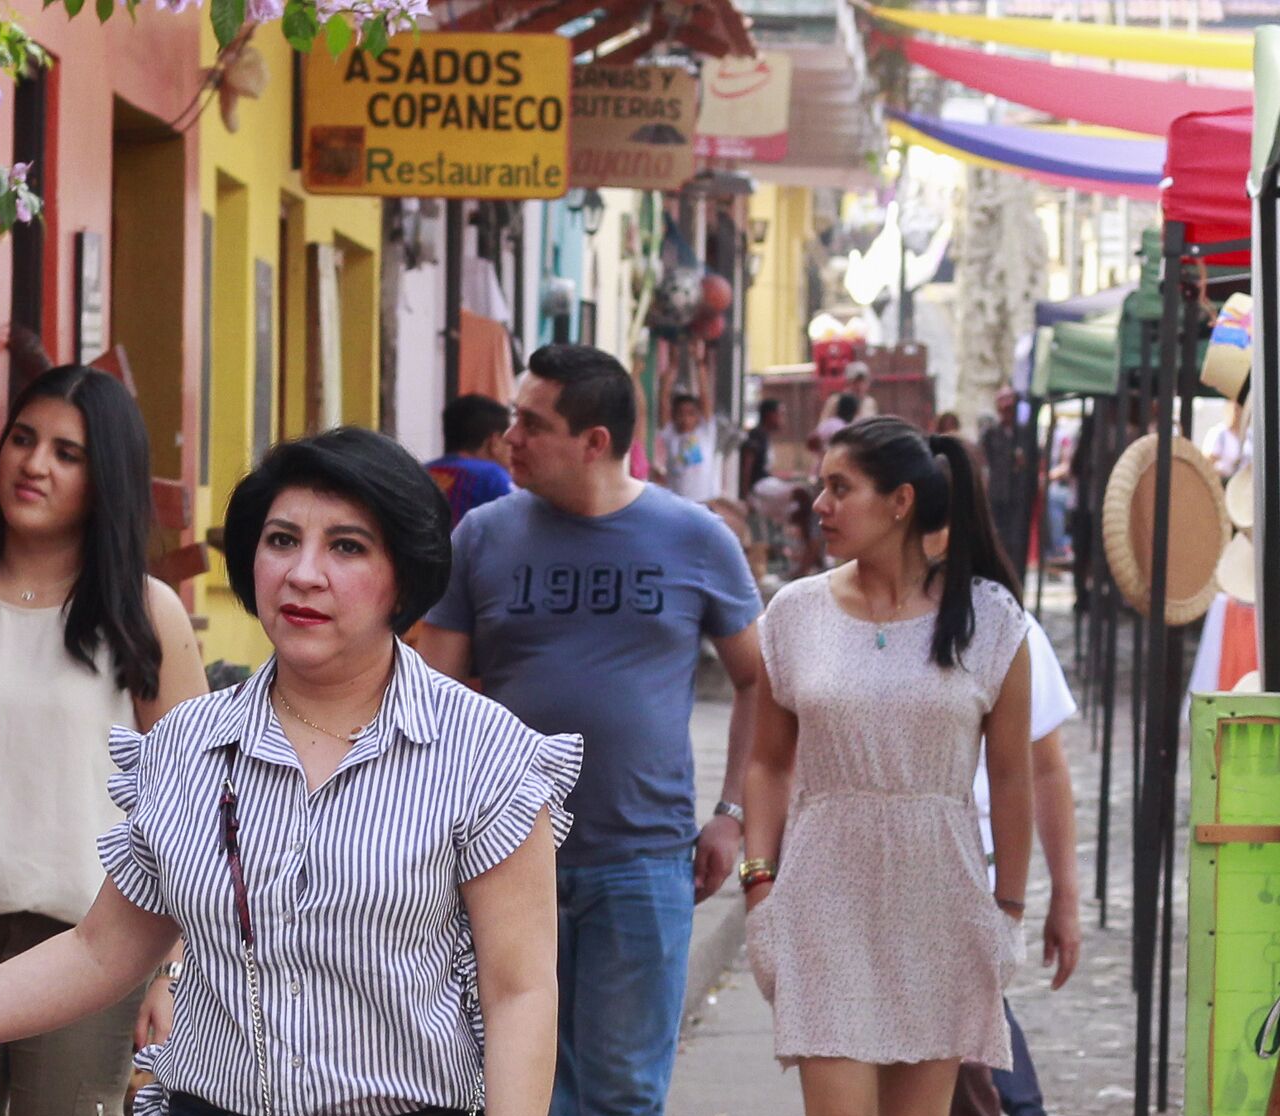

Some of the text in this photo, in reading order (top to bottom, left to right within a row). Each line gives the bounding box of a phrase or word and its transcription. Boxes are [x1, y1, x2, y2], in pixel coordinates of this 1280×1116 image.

[344, 47, 523, 86] ASADOS
[367, 92, 563, 132] COPANECO
[366, 148, 562, 188] Restaurante
[505, 562, 665, 616] 1985
